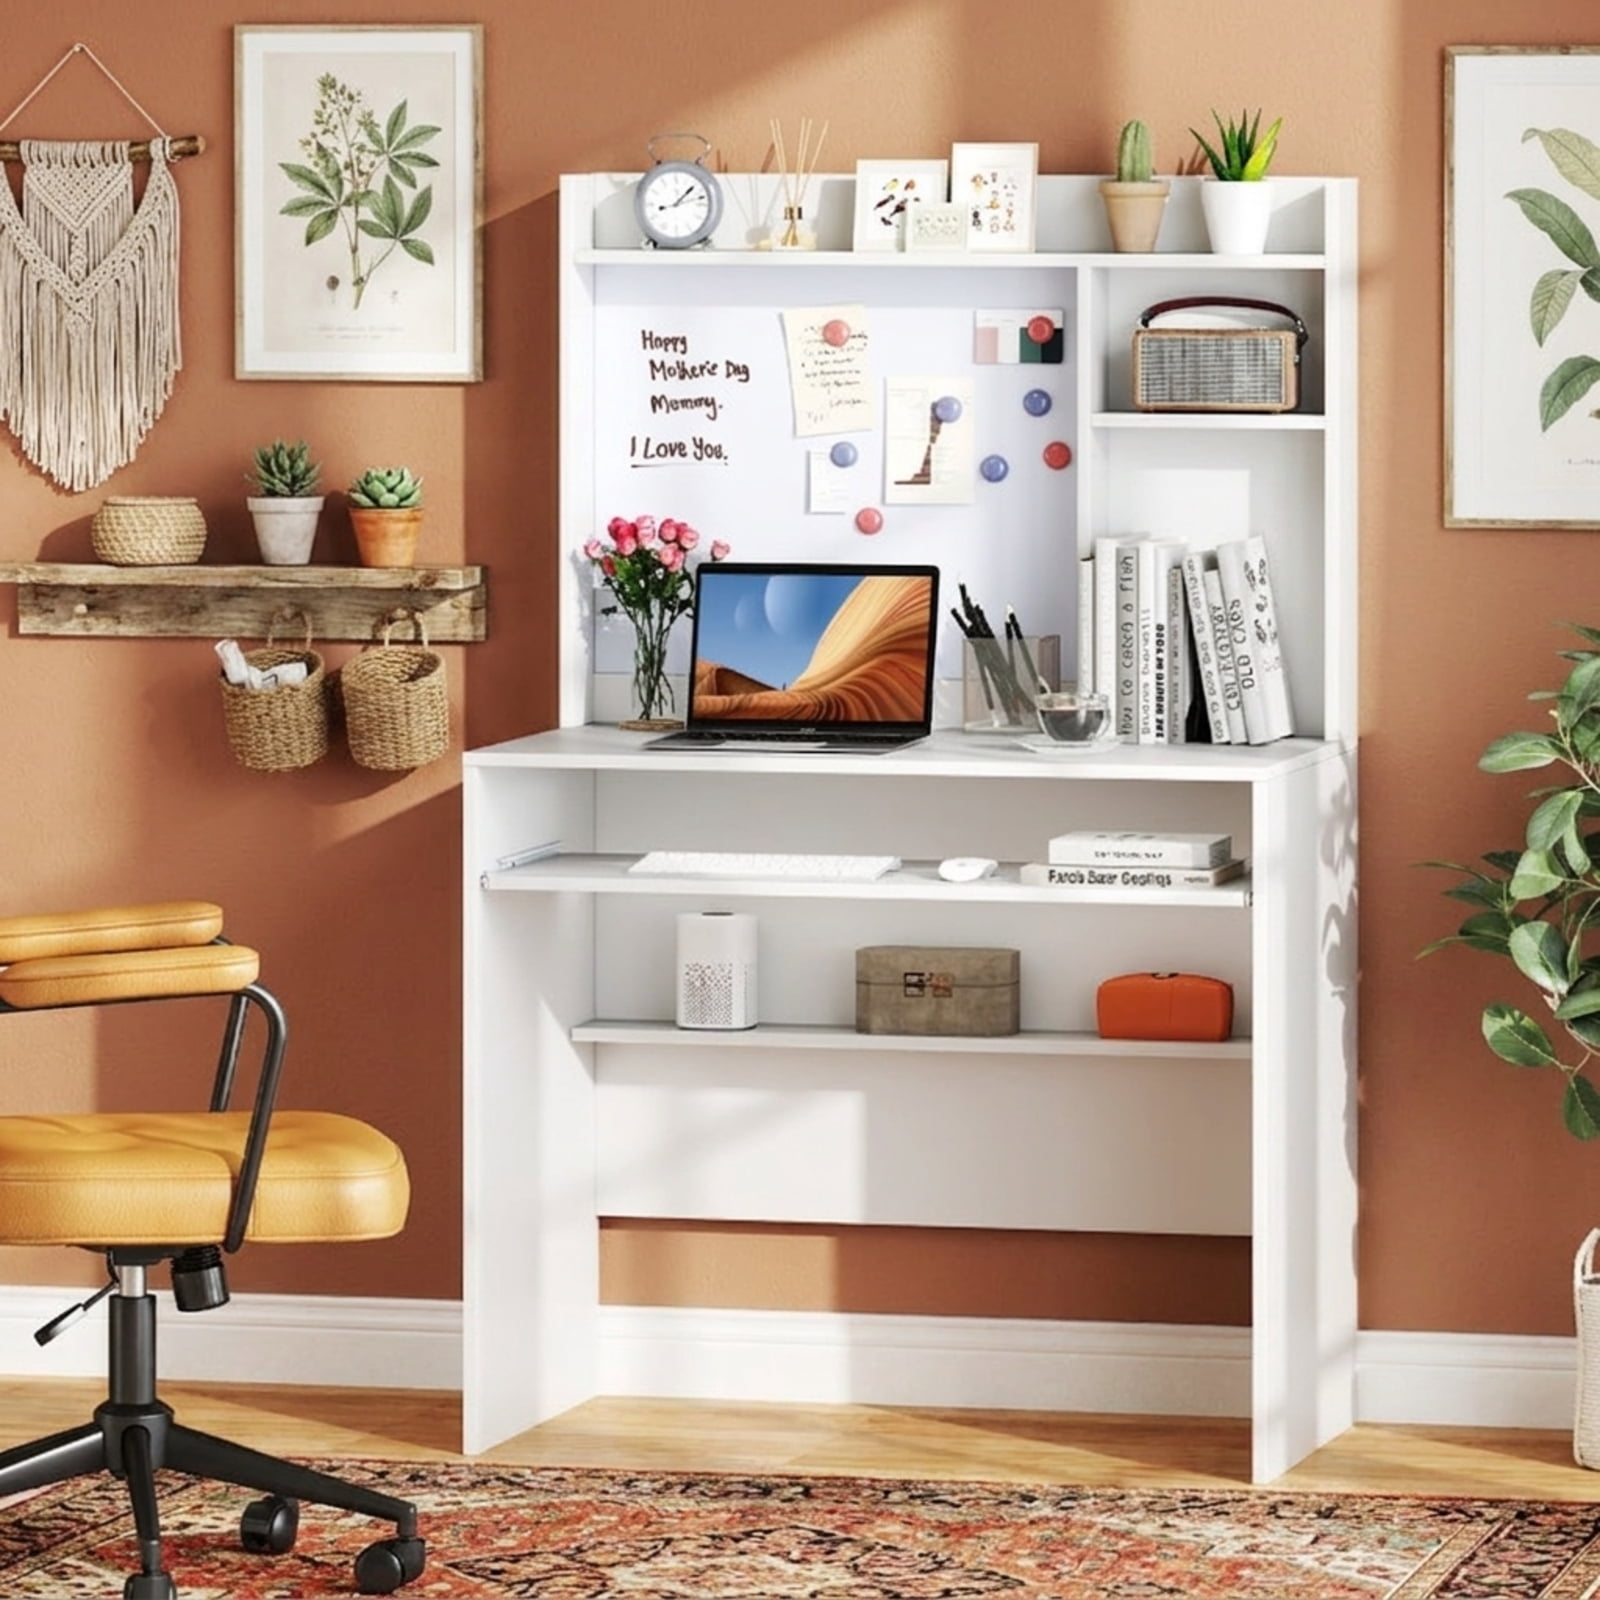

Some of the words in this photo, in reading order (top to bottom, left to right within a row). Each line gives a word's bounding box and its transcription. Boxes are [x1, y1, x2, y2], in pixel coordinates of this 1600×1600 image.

[630, 435, 636, 457] I
[643, 437, 687, 459] Love
[1237, 654, 1255, 690] OLD
